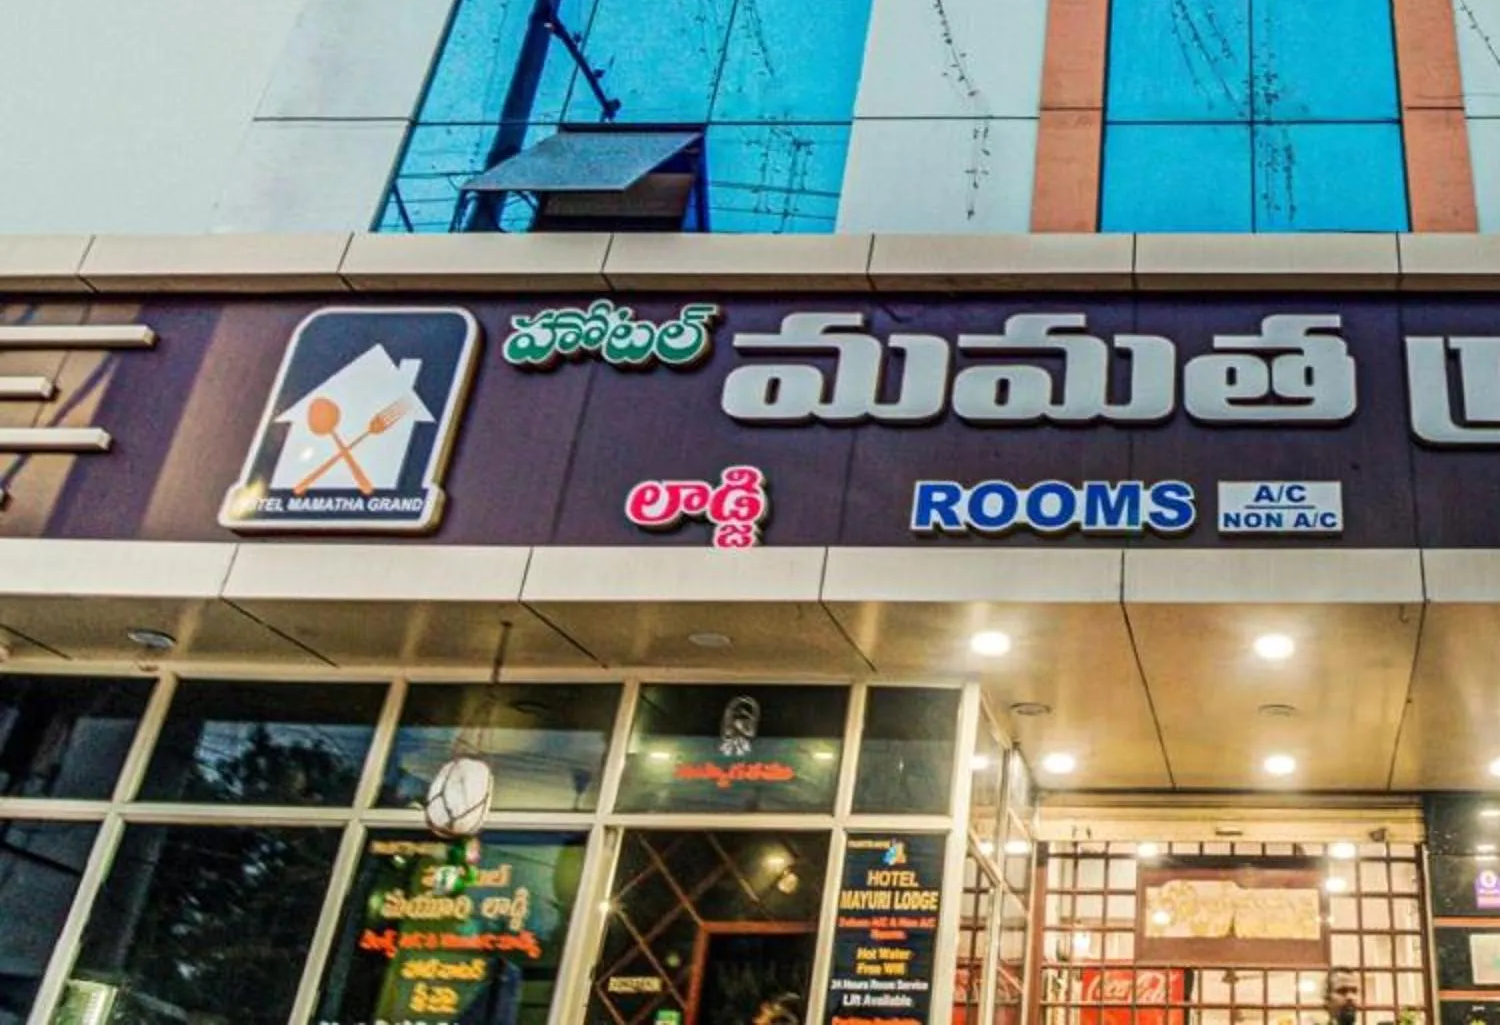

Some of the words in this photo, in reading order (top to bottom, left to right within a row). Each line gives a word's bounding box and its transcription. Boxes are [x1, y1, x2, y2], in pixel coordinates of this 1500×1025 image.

[503, 298, 720, 363] హోటల్
[722, 312, 1357, 421] మమత
[1253, 484, 1307, 503] A/C
[287, 496, 365, 511] MAMATHA
[367, 496, 424, 511] GRAND
[911, 480, 1196, 530] ROOMS
[1223, 512, 1283, 528] NON
[1294, 511, 1337, 528] A/C
[866, 870, 919, 887] HOTEL
[840, 890, 892, 910] MAYURI
[894, 890, 939, 911] LODGE
